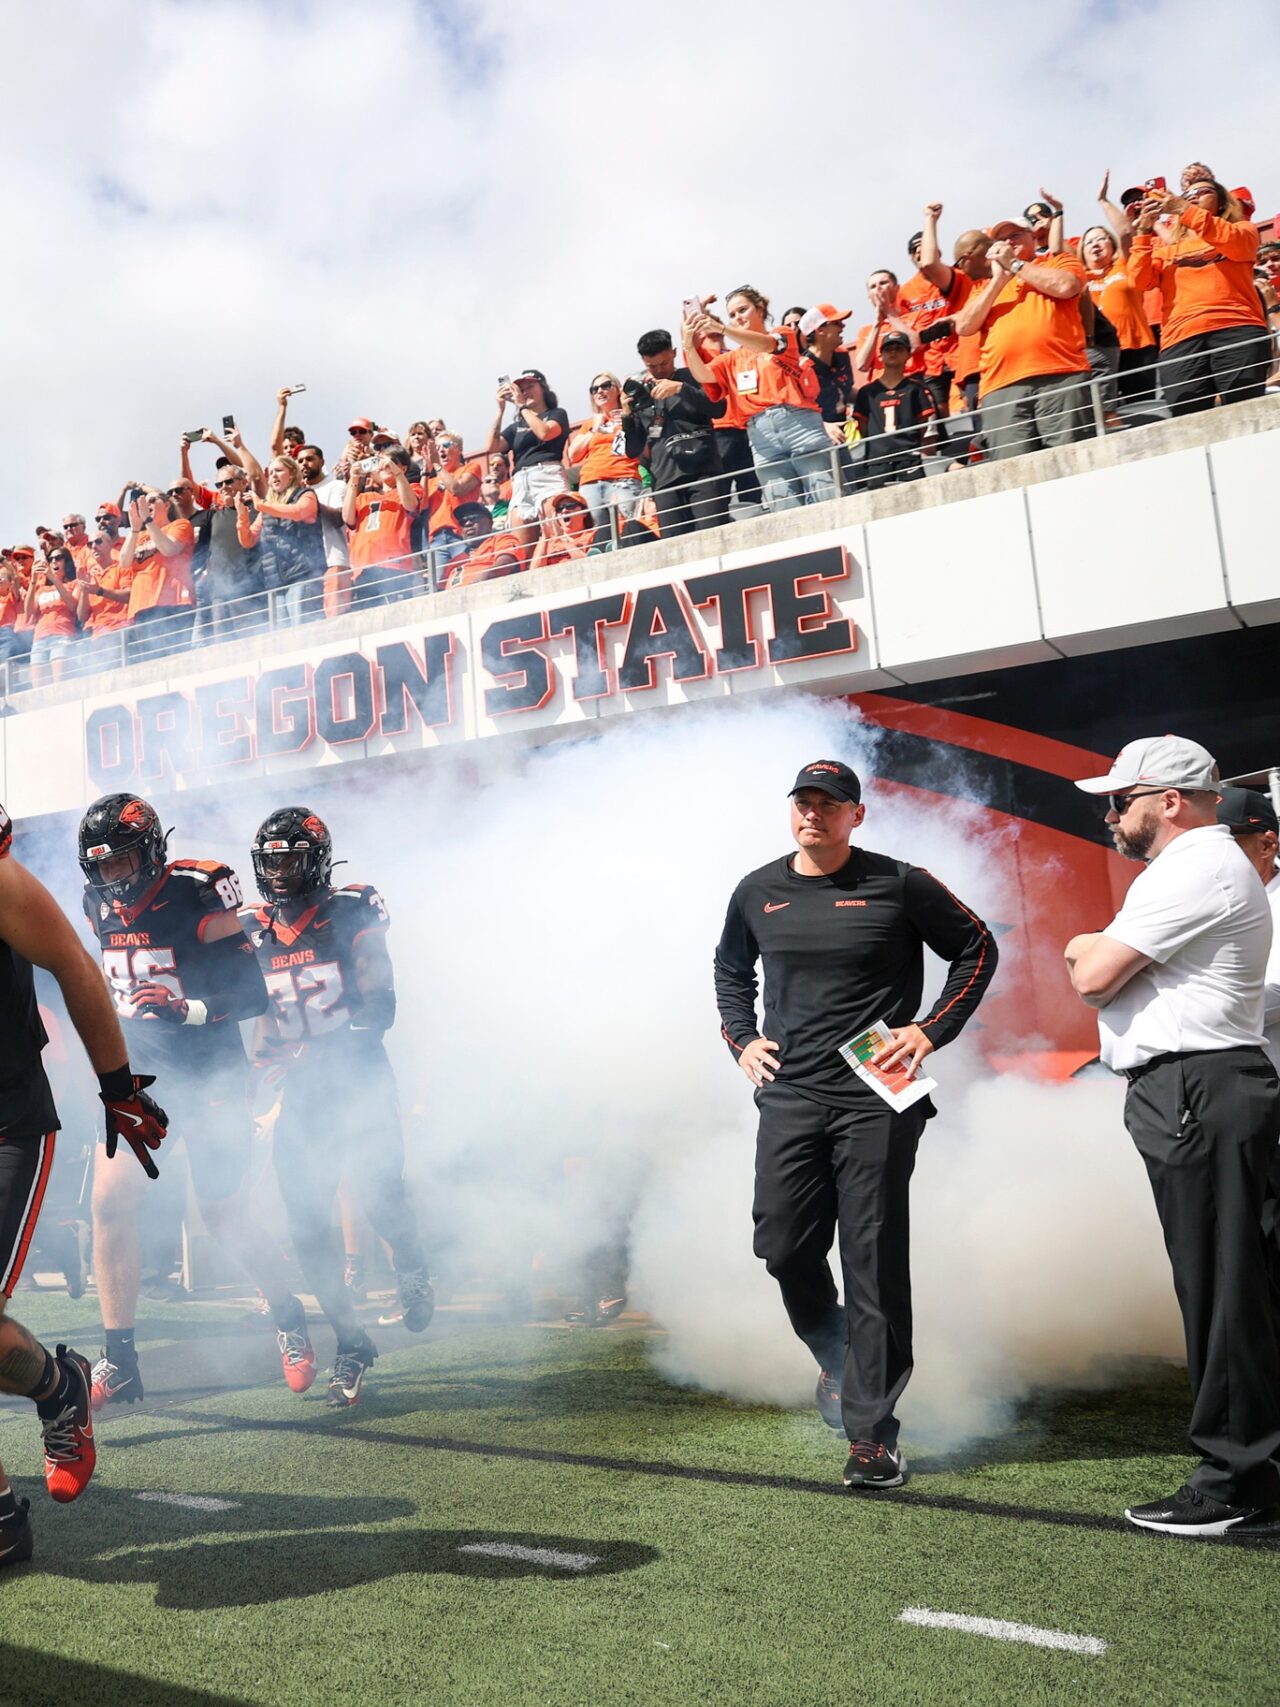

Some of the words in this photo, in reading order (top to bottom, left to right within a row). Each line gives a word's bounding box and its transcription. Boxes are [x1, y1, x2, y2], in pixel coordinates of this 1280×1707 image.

[883, 405, 896, 434] 1
[86, 631, 460, 788] OREGON
[480, 544, 858, 718] STATE
[805, 763, 840, 775] BEAVERS
[835, 900, 868, 908] BEAVERS
[109, 932, 152, 947] BEAVS
[271, 949, 315, 970] BEAVS
[263, 960, 352, 1039] 32
